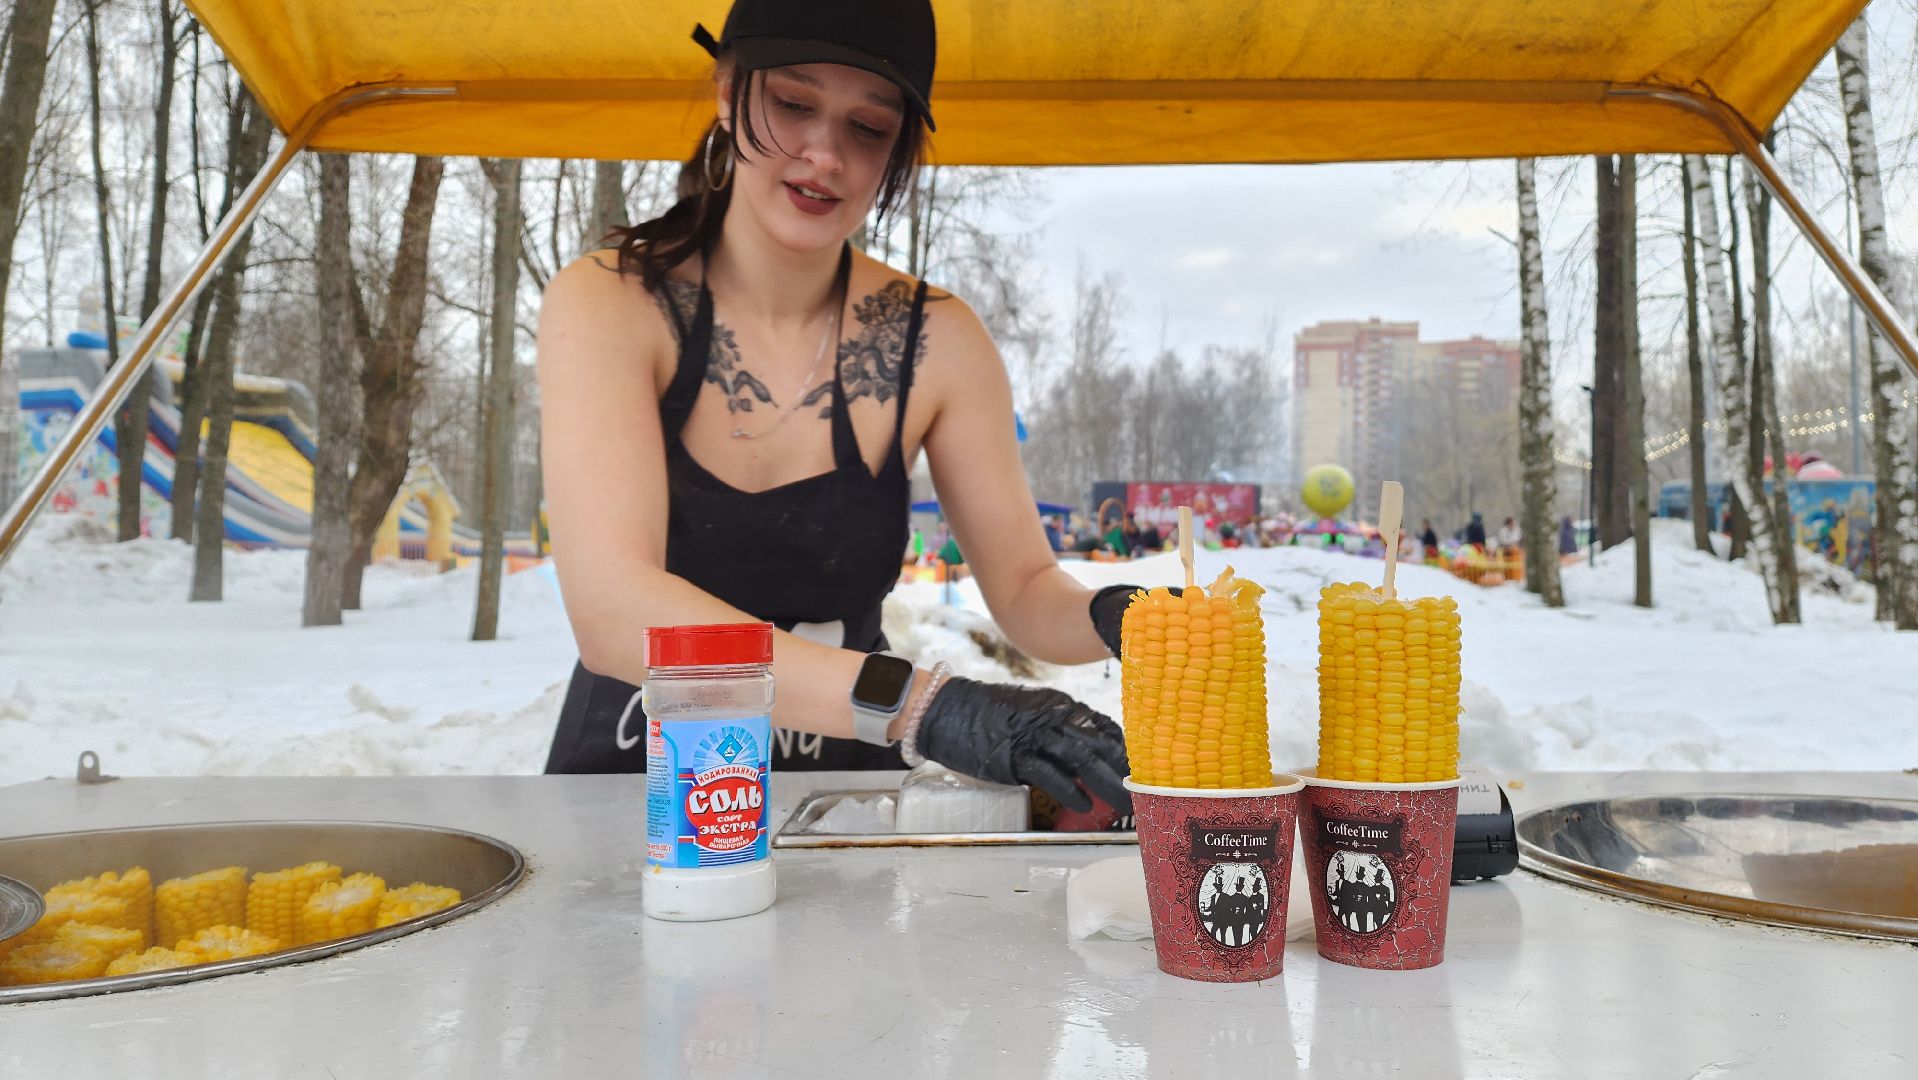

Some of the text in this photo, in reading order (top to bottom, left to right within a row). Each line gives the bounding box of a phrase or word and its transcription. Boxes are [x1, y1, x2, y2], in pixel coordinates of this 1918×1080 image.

[688, 785, 762, 815] СОЛЬ
[698, 820, 757, 836] ЭКСТРА
[1326, 821, 1389, 839] CoffeeTime
[1204, 832, 1268, 847] CoffeeTime
